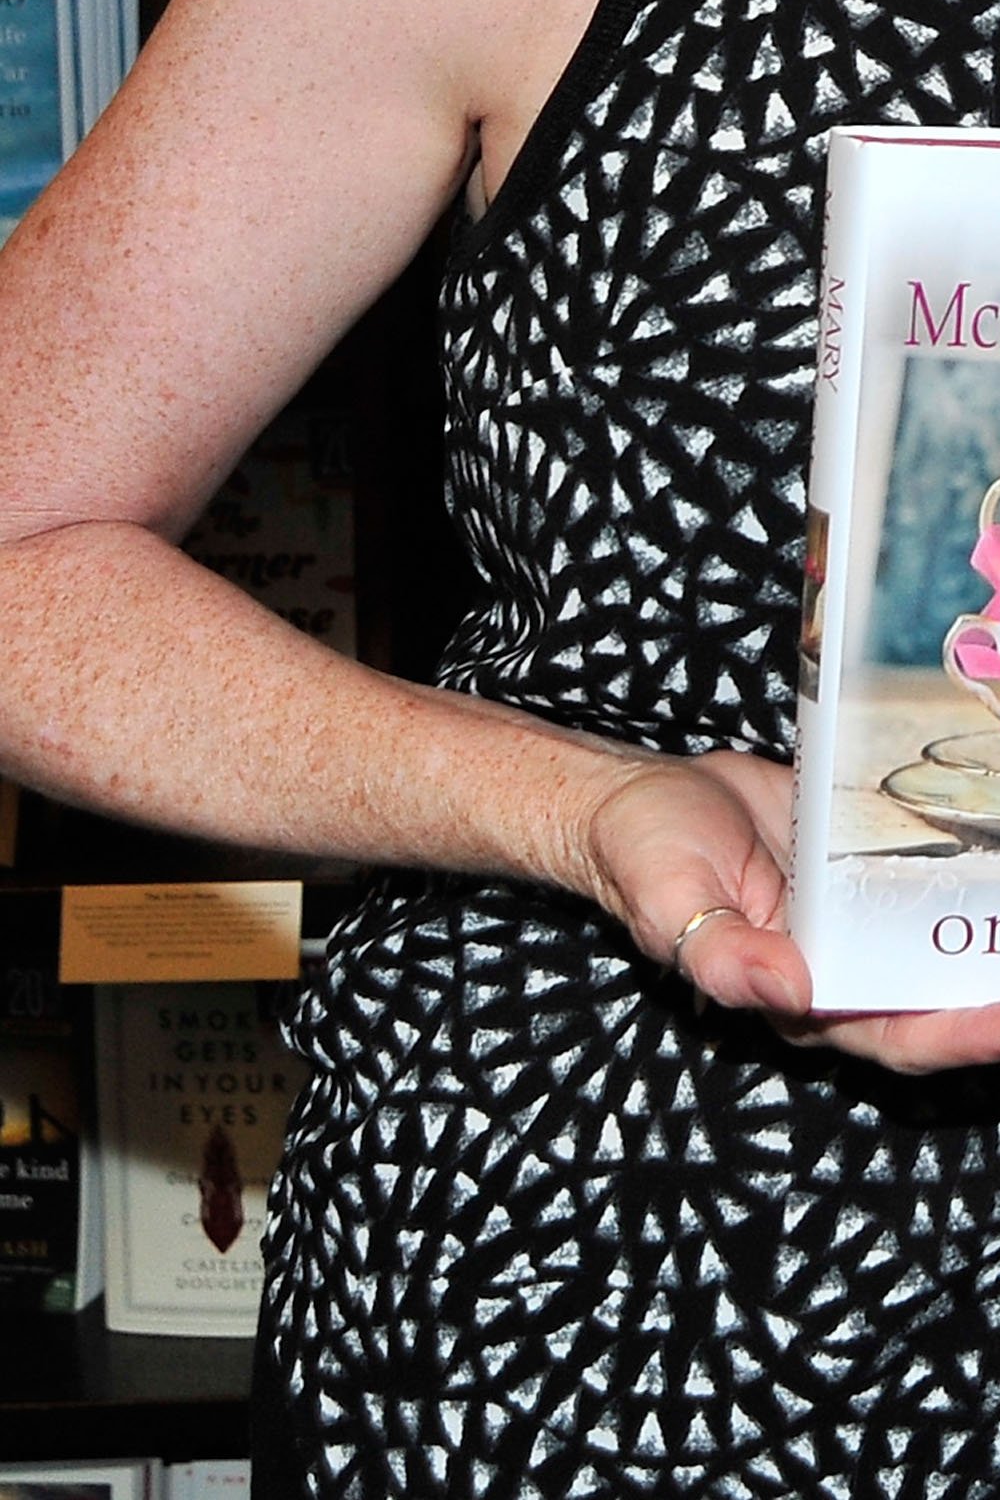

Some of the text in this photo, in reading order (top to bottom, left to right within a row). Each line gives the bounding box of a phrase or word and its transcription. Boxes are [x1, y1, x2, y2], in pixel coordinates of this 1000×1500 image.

[823, 276, 846, 393] MARY
[157, 1008, 252, 1031] SMOK
[175, 1040, 258, 1063] GETS
[148, 1071, 288, 1093] IN YOUR
[180, 1104, 258, 1126] EYES
[16, 1156, 70, 1182] kind
